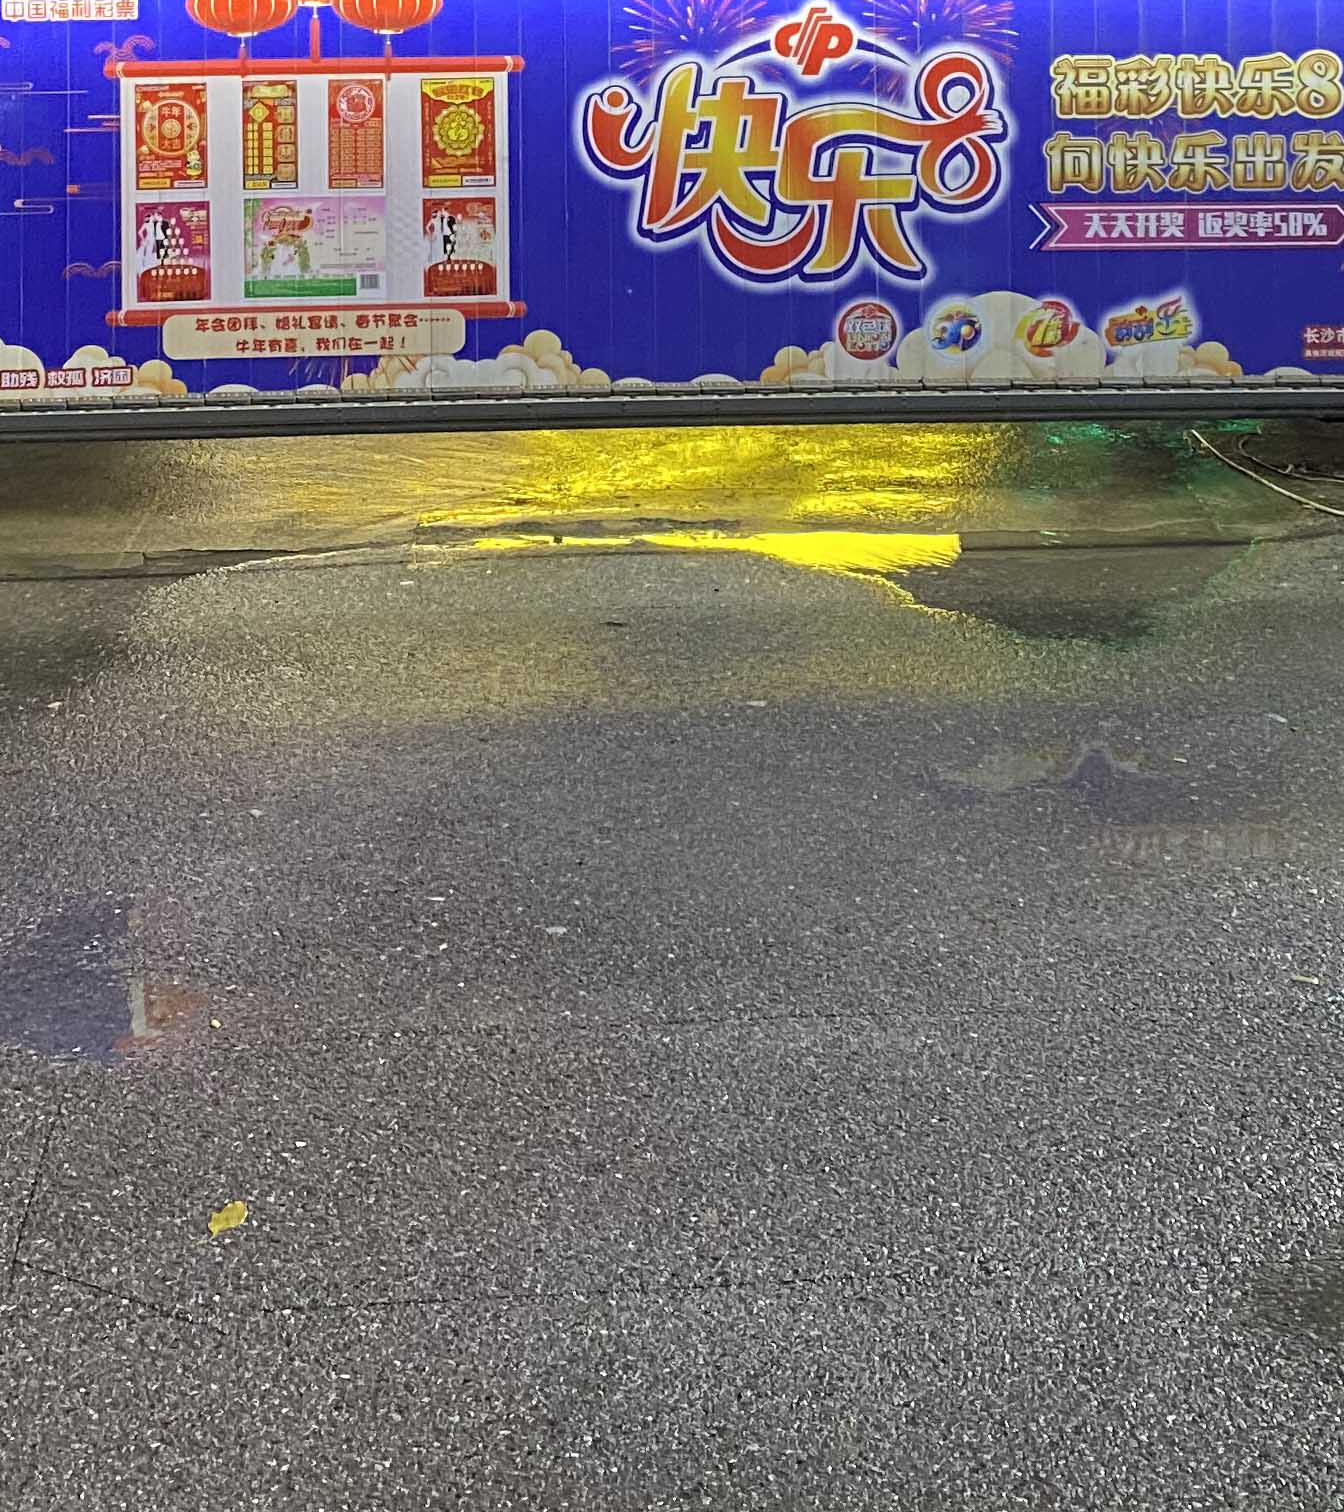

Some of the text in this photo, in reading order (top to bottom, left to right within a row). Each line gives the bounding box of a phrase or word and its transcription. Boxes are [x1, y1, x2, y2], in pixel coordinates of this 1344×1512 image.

[1051, 50, 1344, 118] 福彩快乐8
[1084, 212, 1185, 239] 天天开奖
[0, 371, 39, 388] 助残
[47, 370, 84, 387] 救孤
[94, 368, 132, 385] 济困
